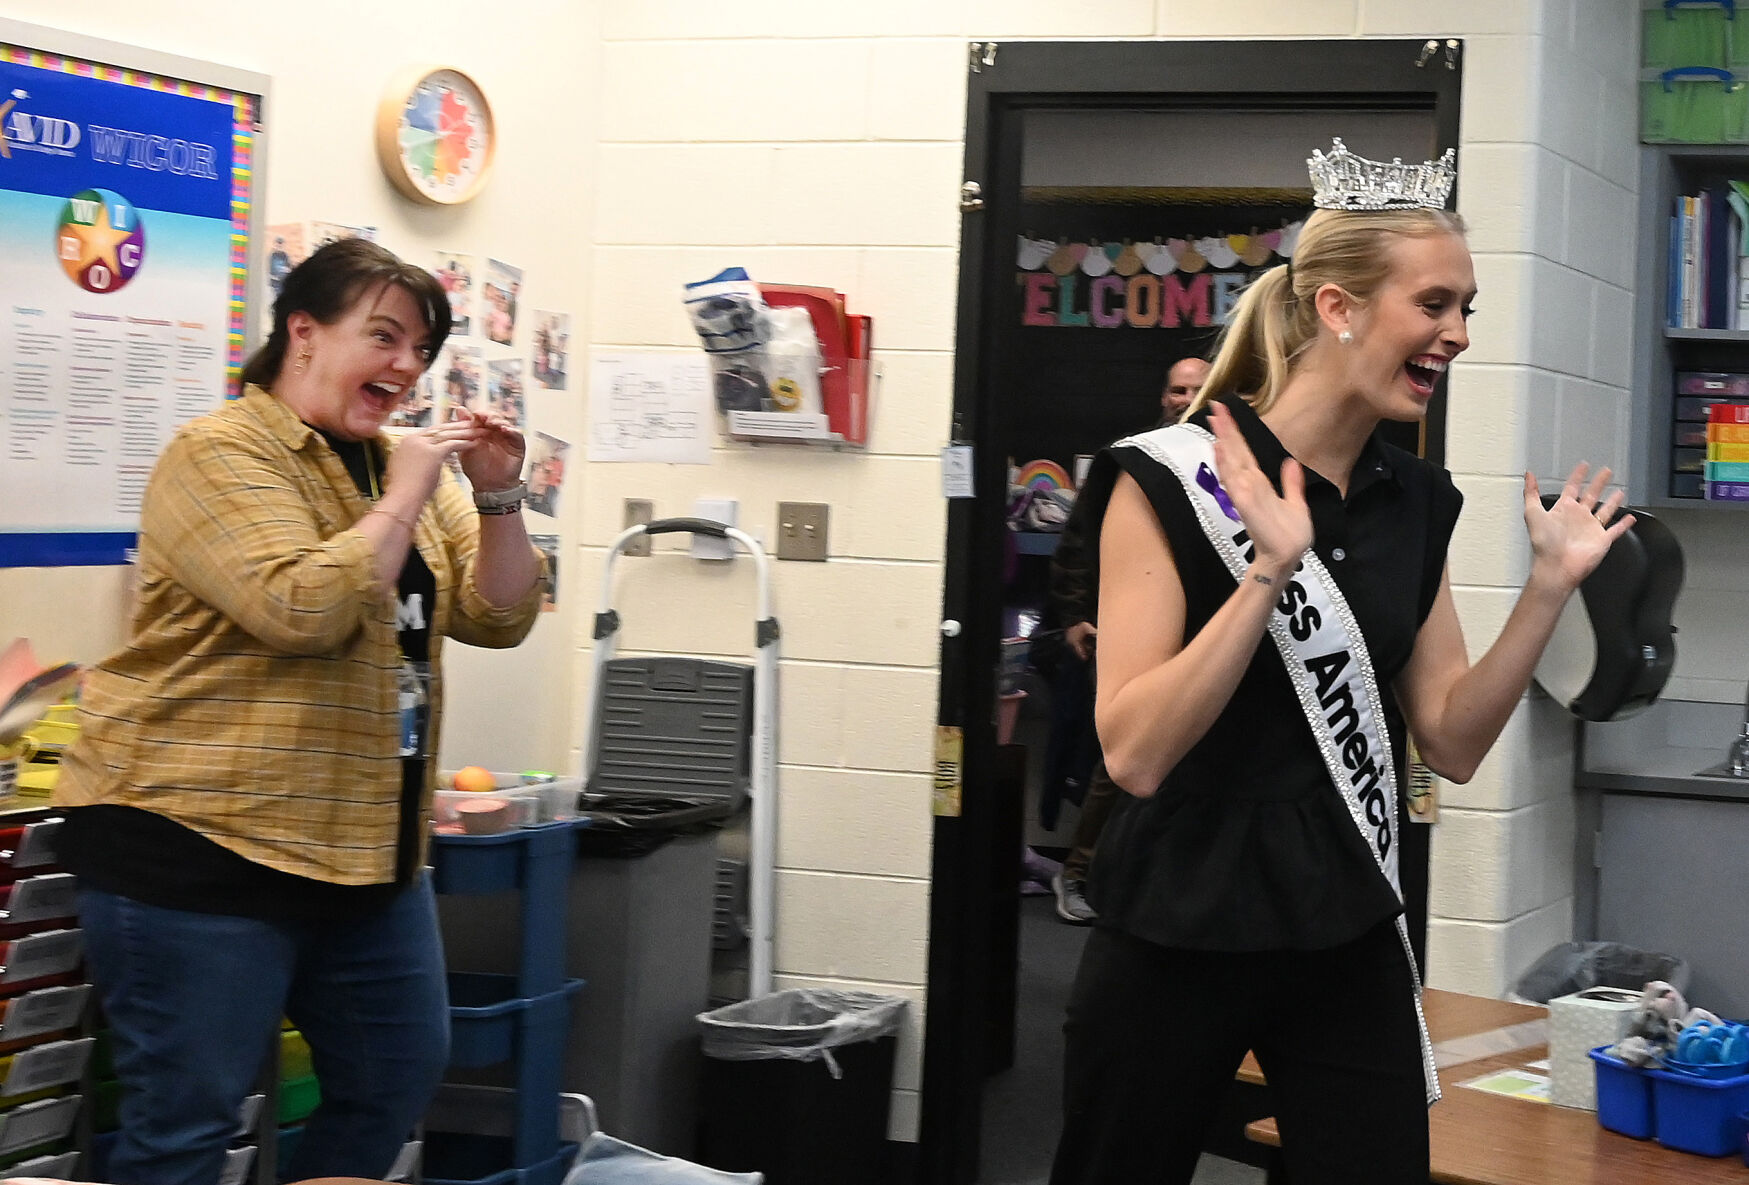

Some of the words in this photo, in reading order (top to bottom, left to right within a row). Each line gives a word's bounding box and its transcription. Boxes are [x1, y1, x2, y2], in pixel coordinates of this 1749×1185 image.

[3, 112, 81, 149] AVID
[88, 124, 218, 180] WICOR
[1018, 272, 1246, 329] ELCOME
[1304, 650, 1392, 862] America
